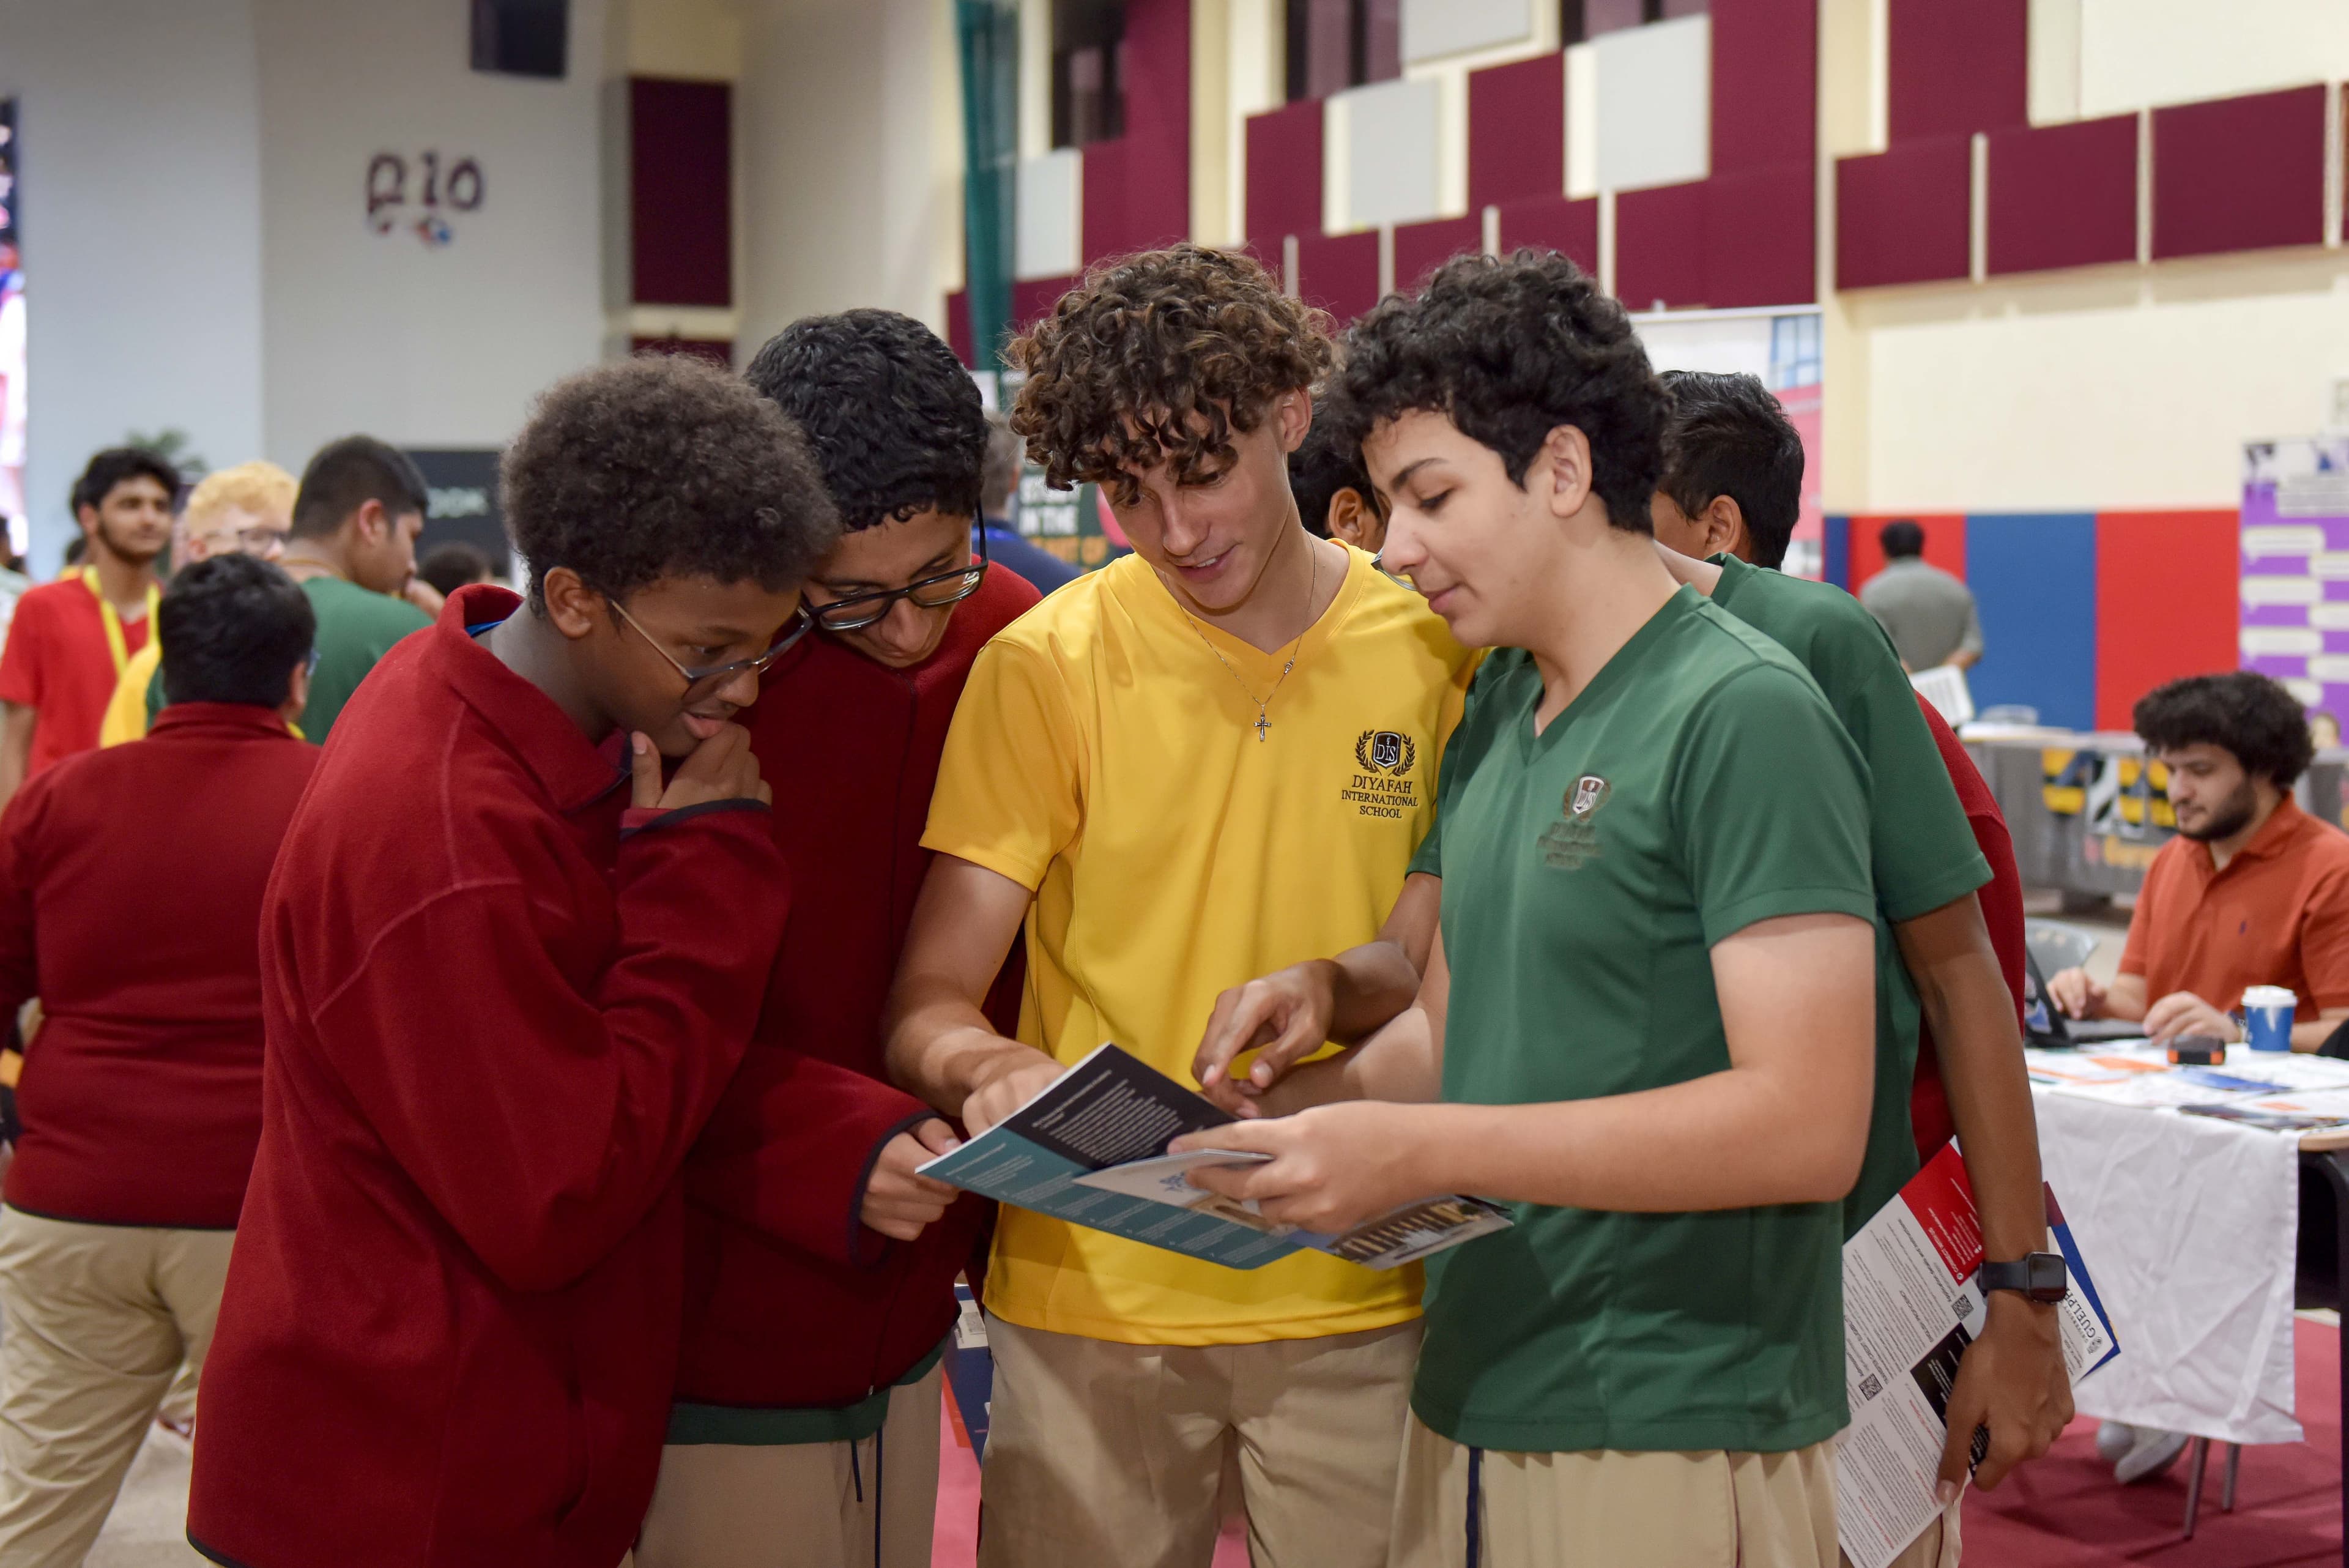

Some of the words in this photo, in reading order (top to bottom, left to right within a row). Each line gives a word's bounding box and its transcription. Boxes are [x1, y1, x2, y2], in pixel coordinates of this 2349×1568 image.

[1375, 744, 1397, 761] DIS
[1351, 775, 1414, 794] DIYAFAH
[1341, 789, 1419, 807] INTERNATIONAL
[1359, 805, 1402, 819] SCHOOL
